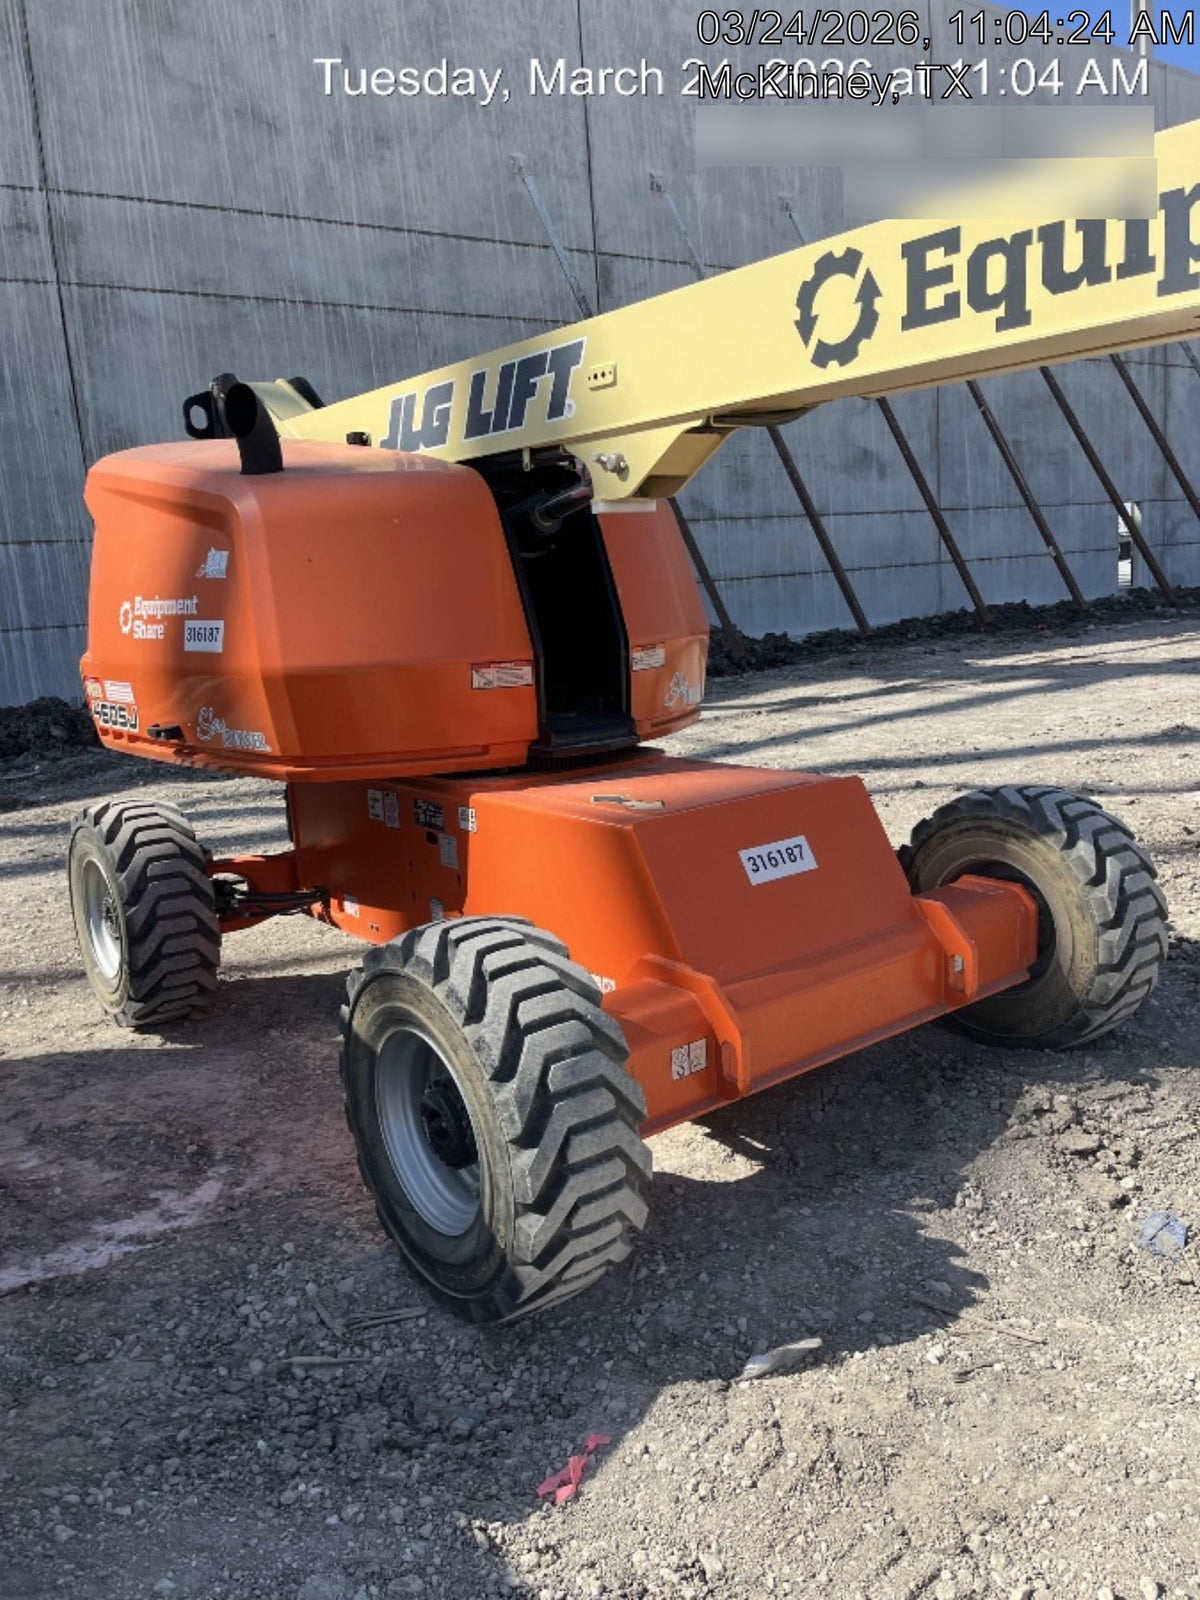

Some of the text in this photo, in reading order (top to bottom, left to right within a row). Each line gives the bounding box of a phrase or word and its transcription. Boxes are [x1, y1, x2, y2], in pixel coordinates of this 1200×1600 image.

[379, 336, 588, 453] JLG LIFT
[134, 595, 199, 620] Equipment
[133, 620, 165, 640] Share
[186, 626, 221, 643] 316187
[747, 843, 805, 873] 316187
